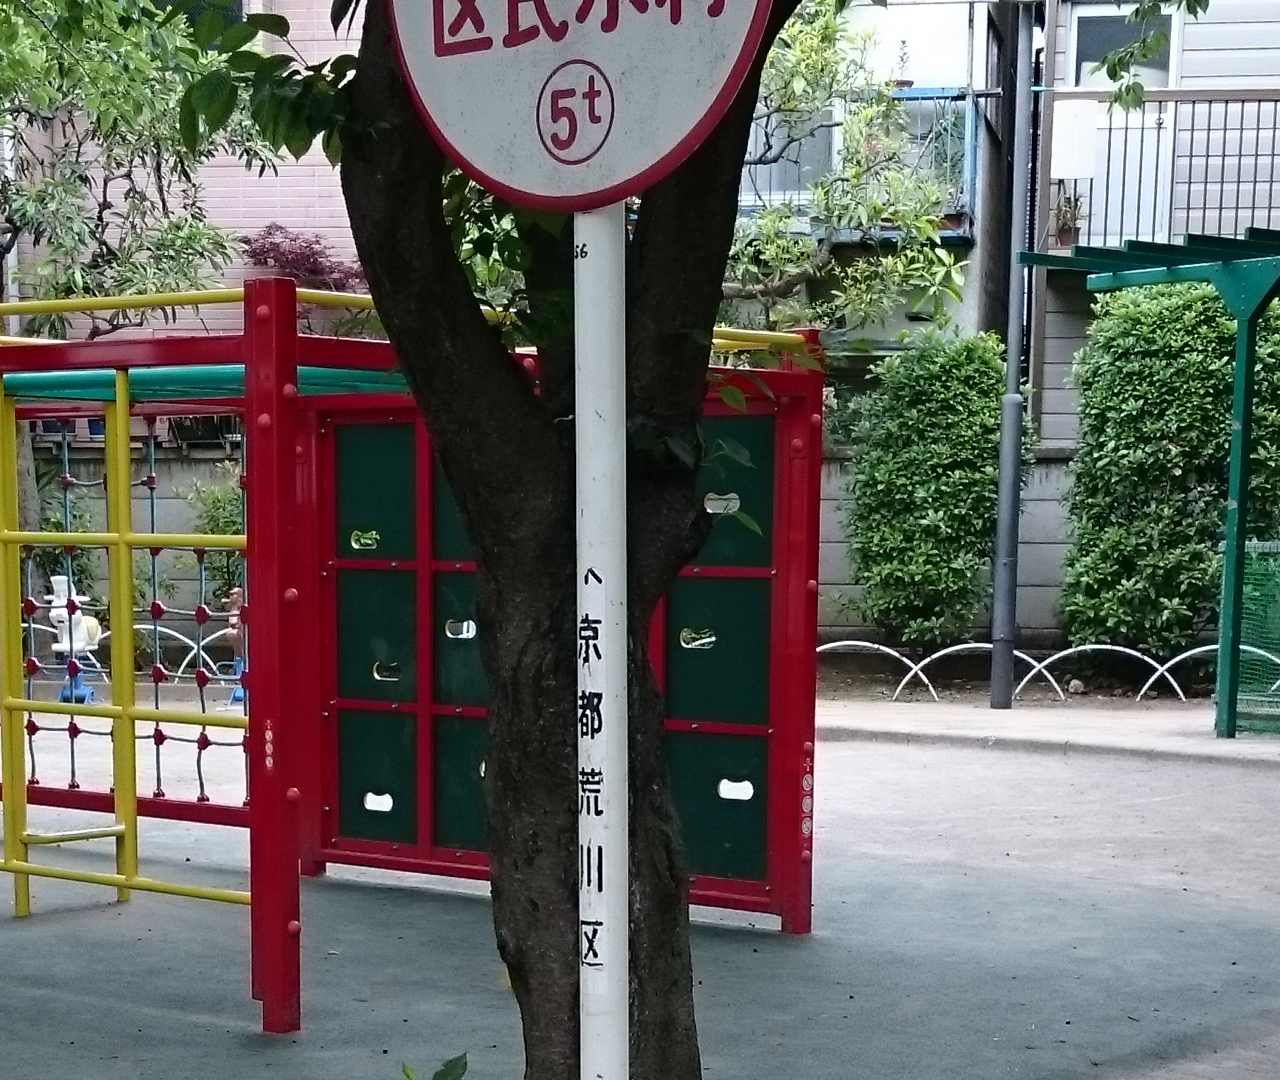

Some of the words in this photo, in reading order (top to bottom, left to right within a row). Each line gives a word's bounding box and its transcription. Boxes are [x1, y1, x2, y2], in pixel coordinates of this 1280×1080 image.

[578, 567, 604, 973] 京都荒川区
